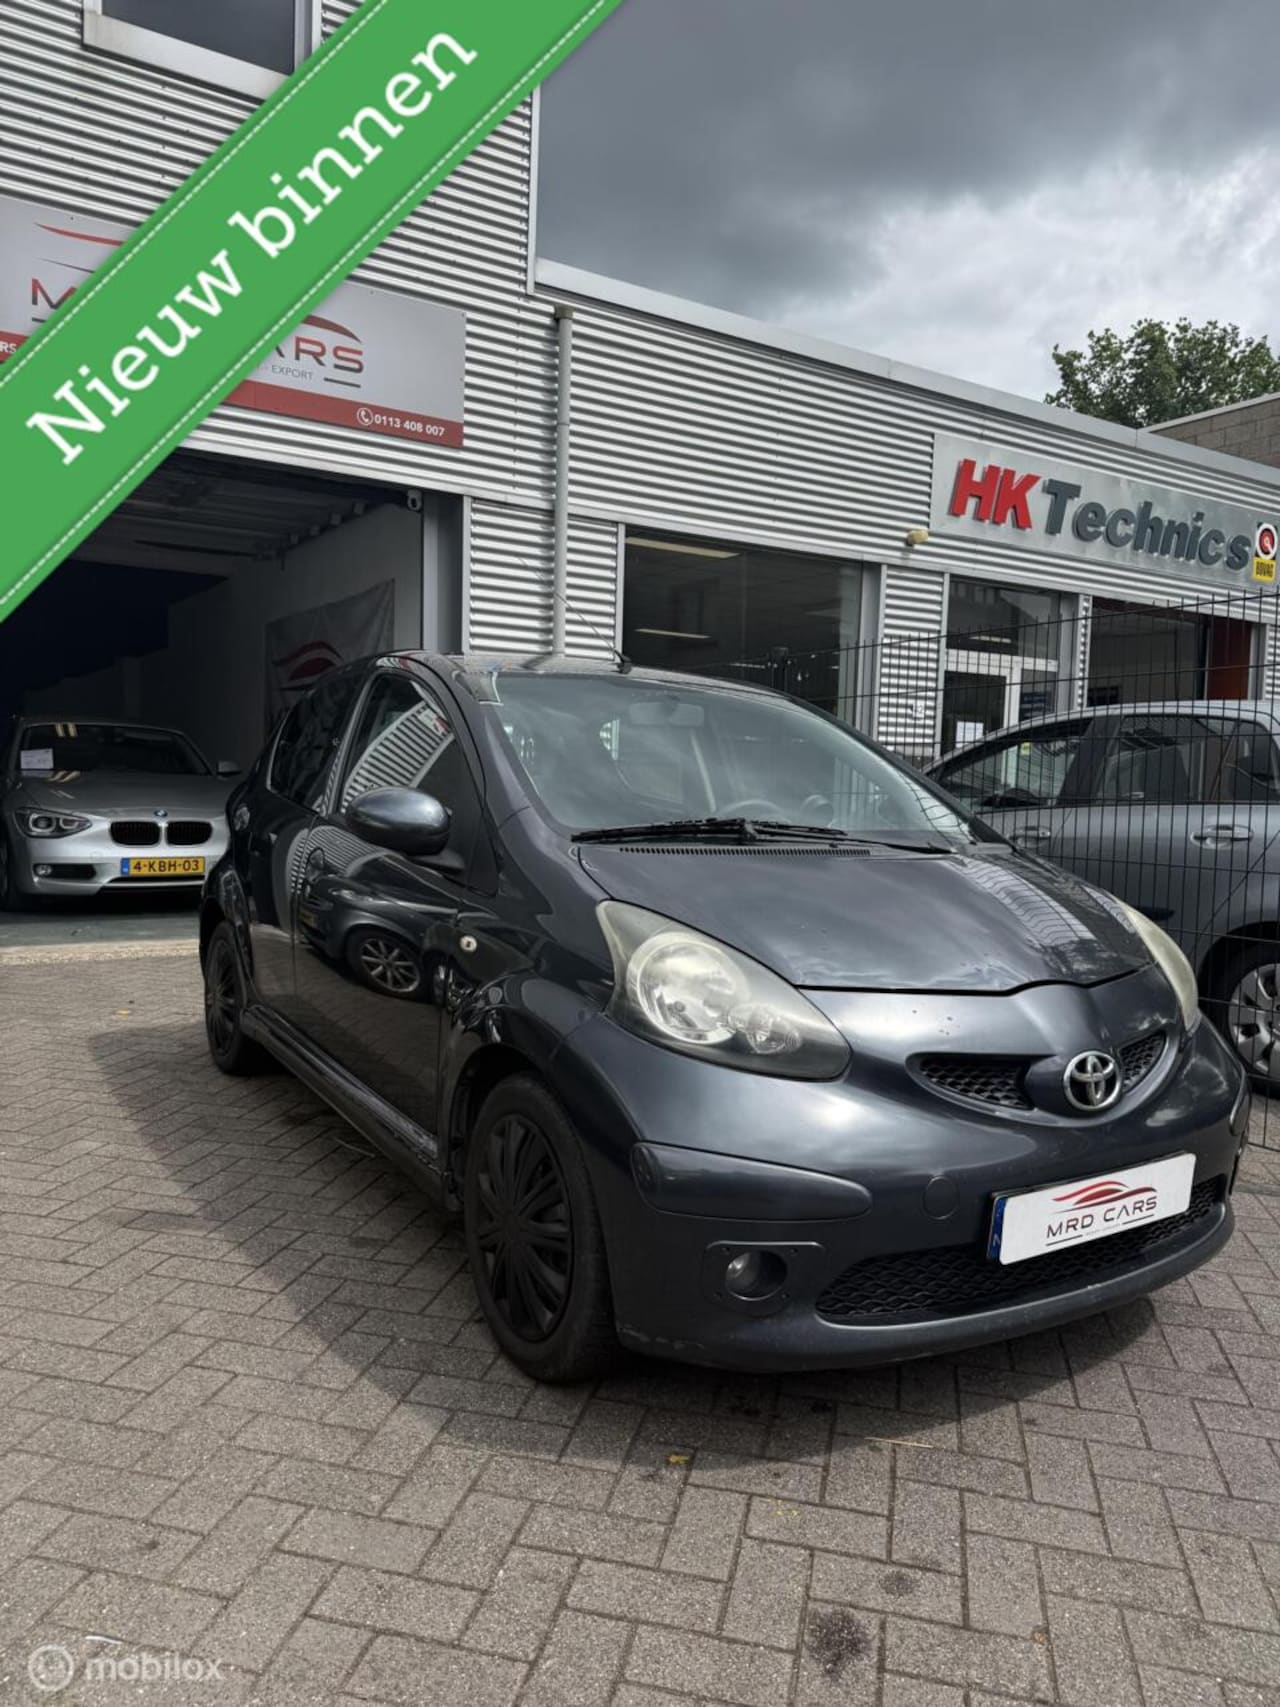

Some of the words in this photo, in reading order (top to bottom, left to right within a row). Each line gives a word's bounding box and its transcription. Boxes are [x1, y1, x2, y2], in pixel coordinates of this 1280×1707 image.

[374, 414, 401, 428] 0113
[403, 420, 423, 432] 408
[425, 424, 445, 437] 007
[133, 859, 200, 873] 4-KBH-03
[1046, 1214, 1094, 1239] MRD
[1103, 1196, 1158, 1222] CARS
